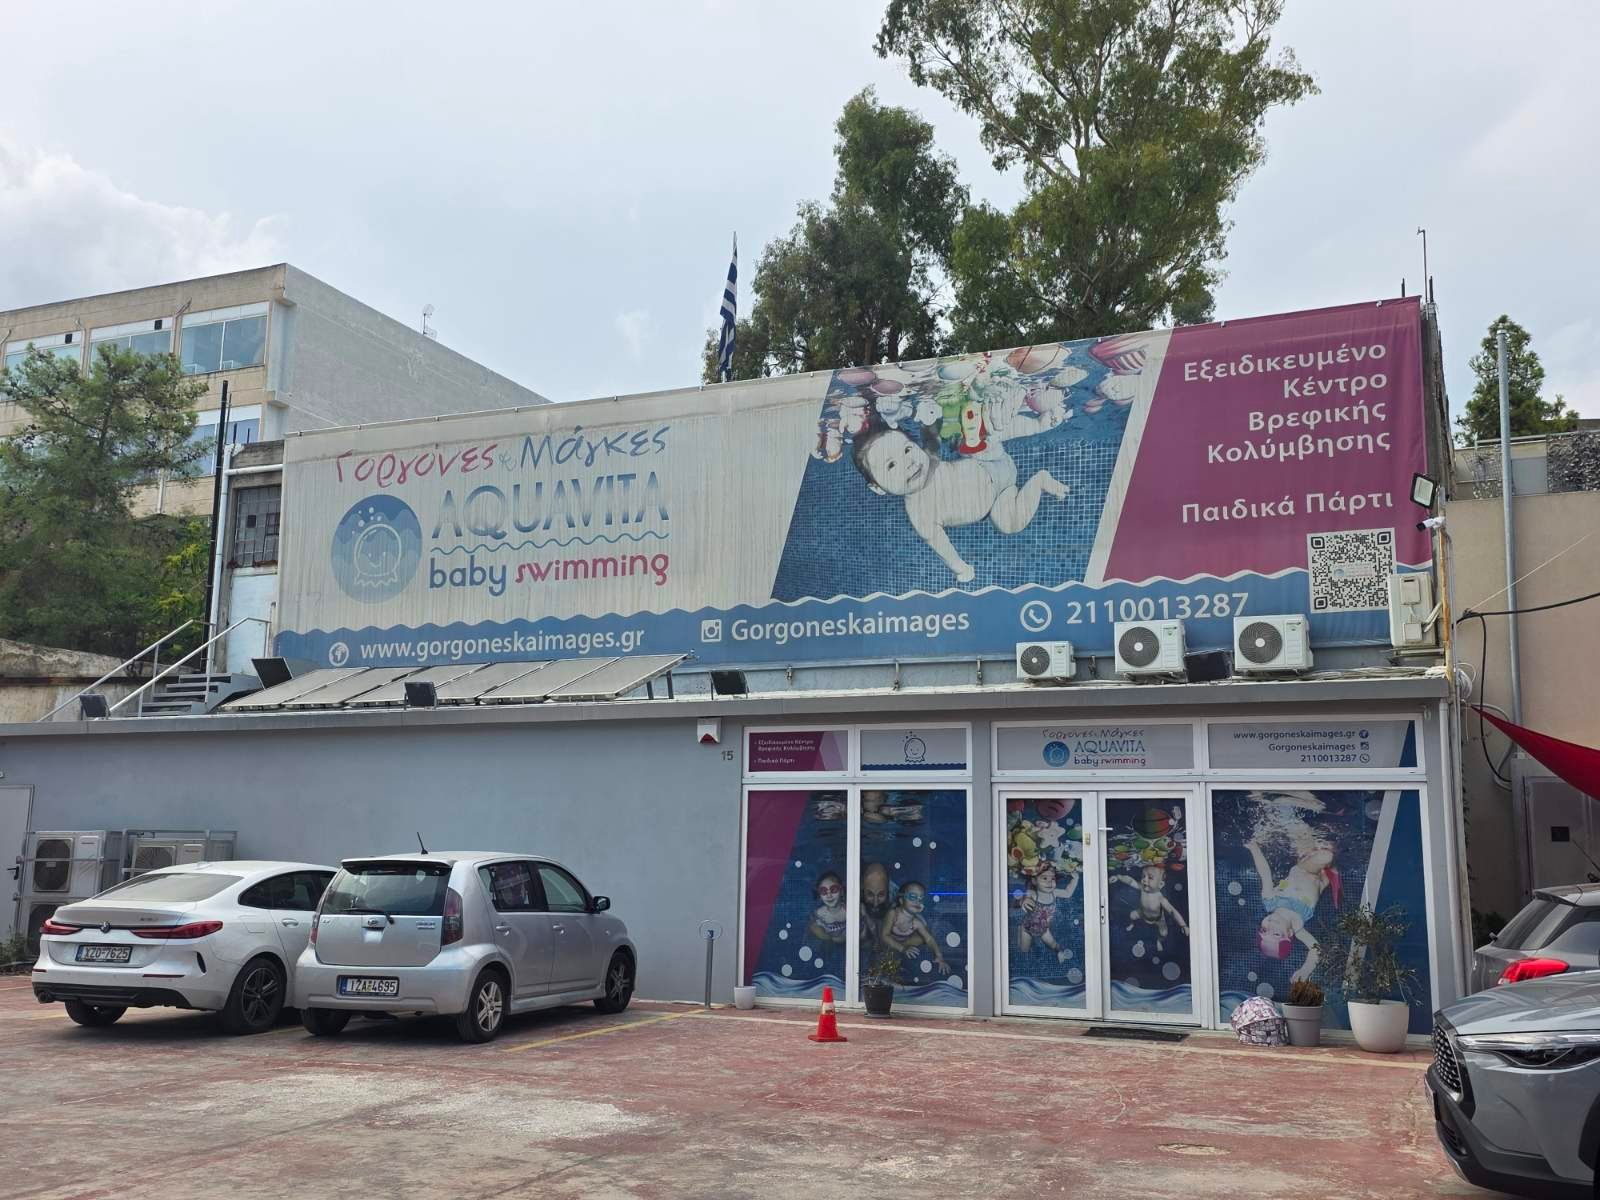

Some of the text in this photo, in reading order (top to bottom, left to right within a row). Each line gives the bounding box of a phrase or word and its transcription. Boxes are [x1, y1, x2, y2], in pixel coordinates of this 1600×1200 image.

[1184, 343, 1387, 382] Εξειδικευμένο
[1284, 373, 1387, 398] Κέντρο
[1249, 400, 1387, 434] Βρεφικής
[520, 424, 671, 470] Μάγκες
[1208, 432, 1391, 464] Κολύμβησης
[431, 471, 669, 540] AQUAVITA
[1182, 490, 1393, 523] Παιδικά Πάρτι
[429, 553, 669, 597] baby swimming
[1066, 592, 1249, 624] 2110013287
[731, 611, 970, 644] Gorgoneskaimages
[360, 629, 645, 662] www.gorgoneskaimages.gr
[1074, 740, 1145, 753] AQUAVITA
[1233, 730, 1355, 740] www.gorgoneskaimages.gr
[1268, 743, 1355, 752] Gorgoneskaimages
[721, 750, 734, 760] 15
[1074, 755, 1098, 767] baby
[1300, 754, 1356, 763] 2110013287
